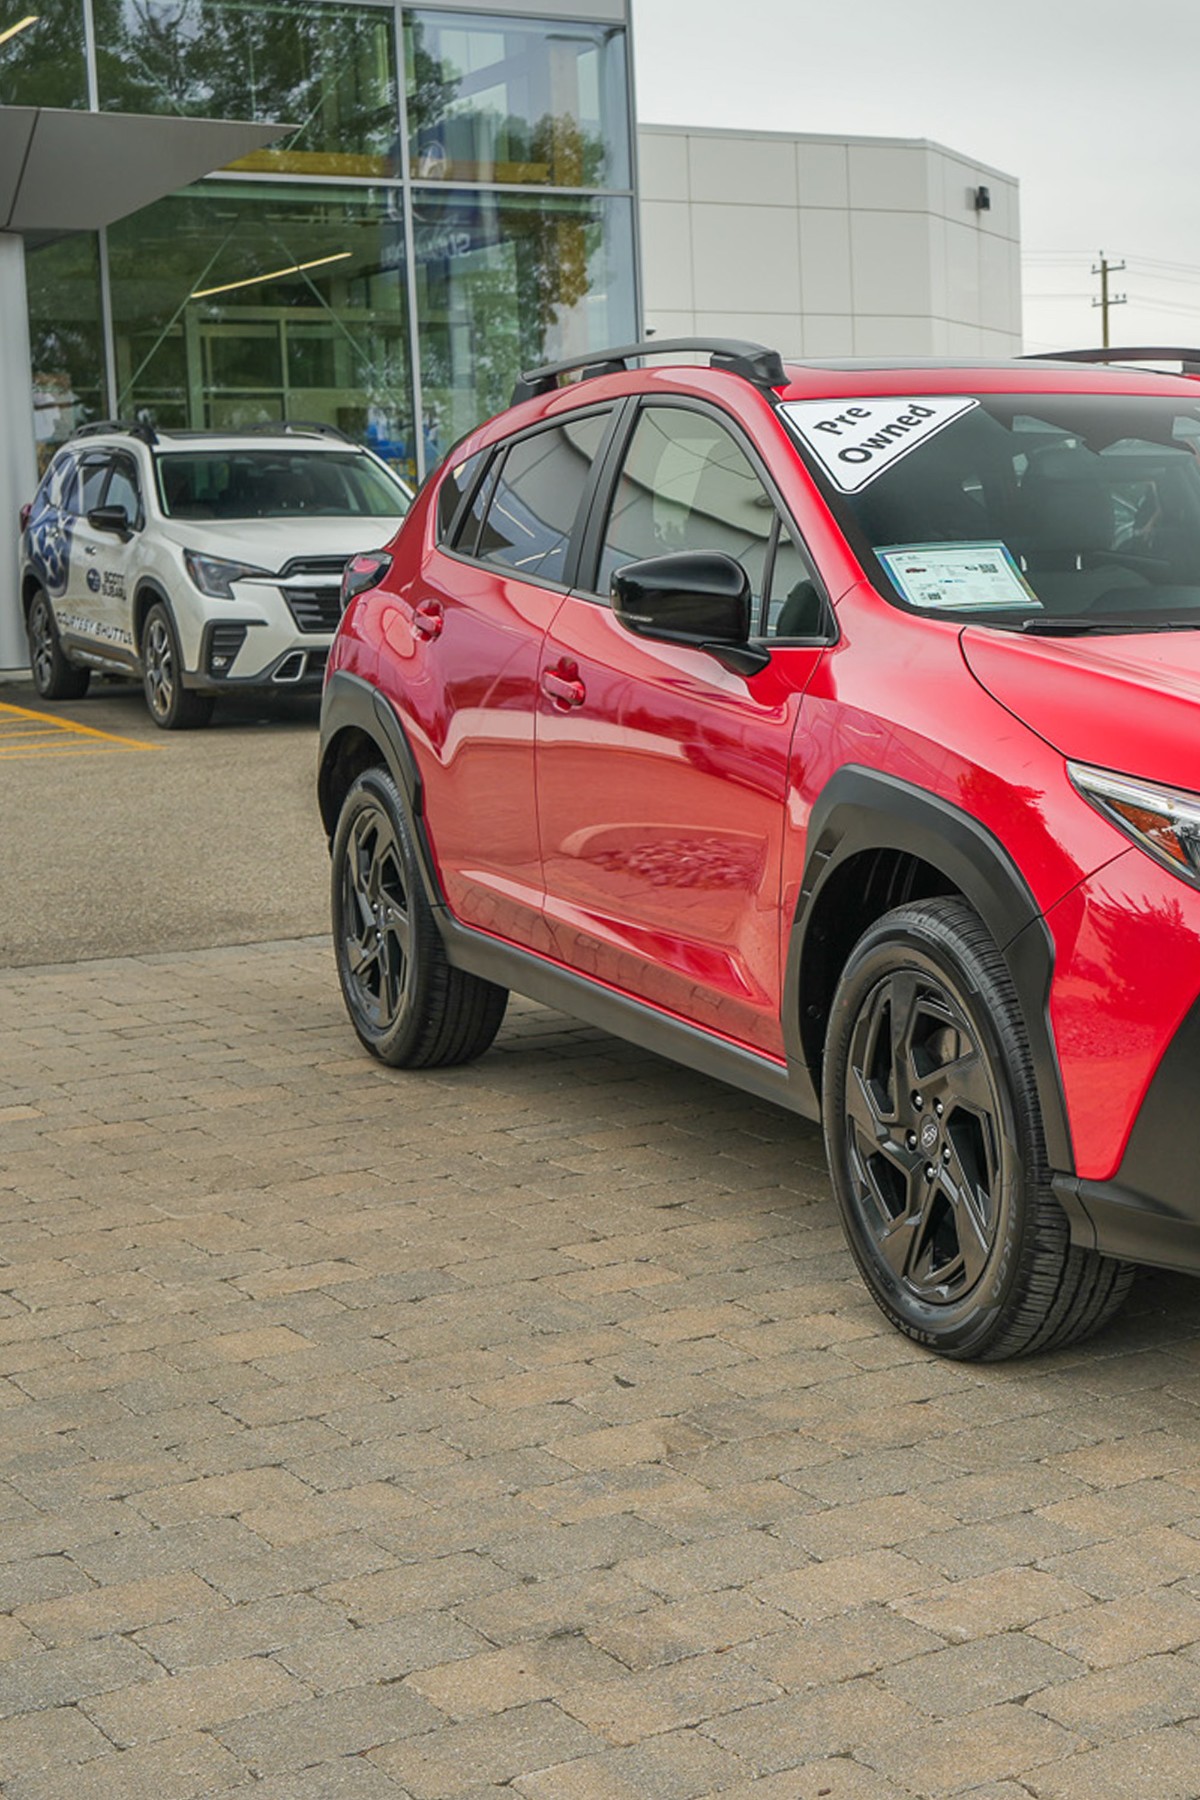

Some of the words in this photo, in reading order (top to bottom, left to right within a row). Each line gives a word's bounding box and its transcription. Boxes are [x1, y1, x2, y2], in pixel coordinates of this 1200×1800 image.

[813, 407, 872, 435] Pre
[838, 404, 936, 463] Owned
[102, 583, 126, 601] SUBARU
[104, 571, 124, 586] SCOTT
[56, 611, 93, 632] COURTESY
[95, 622, 132, 645] SHUTTLE
